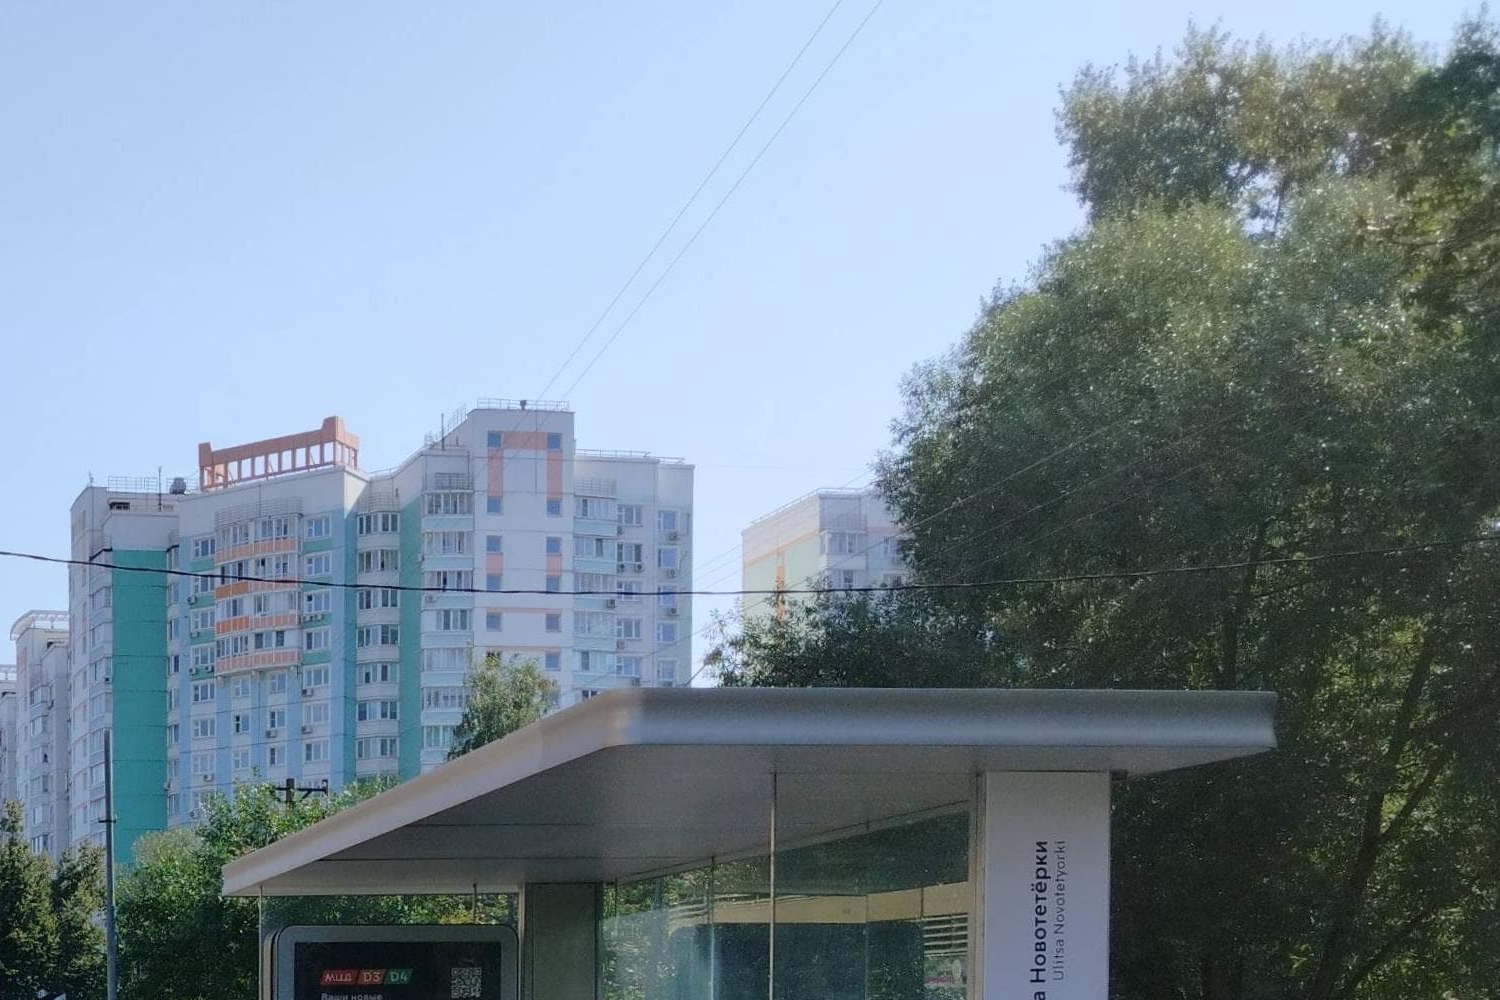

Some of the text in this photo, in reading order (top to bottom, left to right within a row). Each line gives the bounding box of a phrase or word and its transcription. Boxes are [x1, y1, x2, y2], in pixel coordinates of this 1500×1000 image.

[363, 971, 381, 982] D3
[390, 971, 408, 982] D4
[1029, 840, 1051, 984] Новотетёрки
[1053, 840, 1068, 981] Ulitsa Novotetyorki
